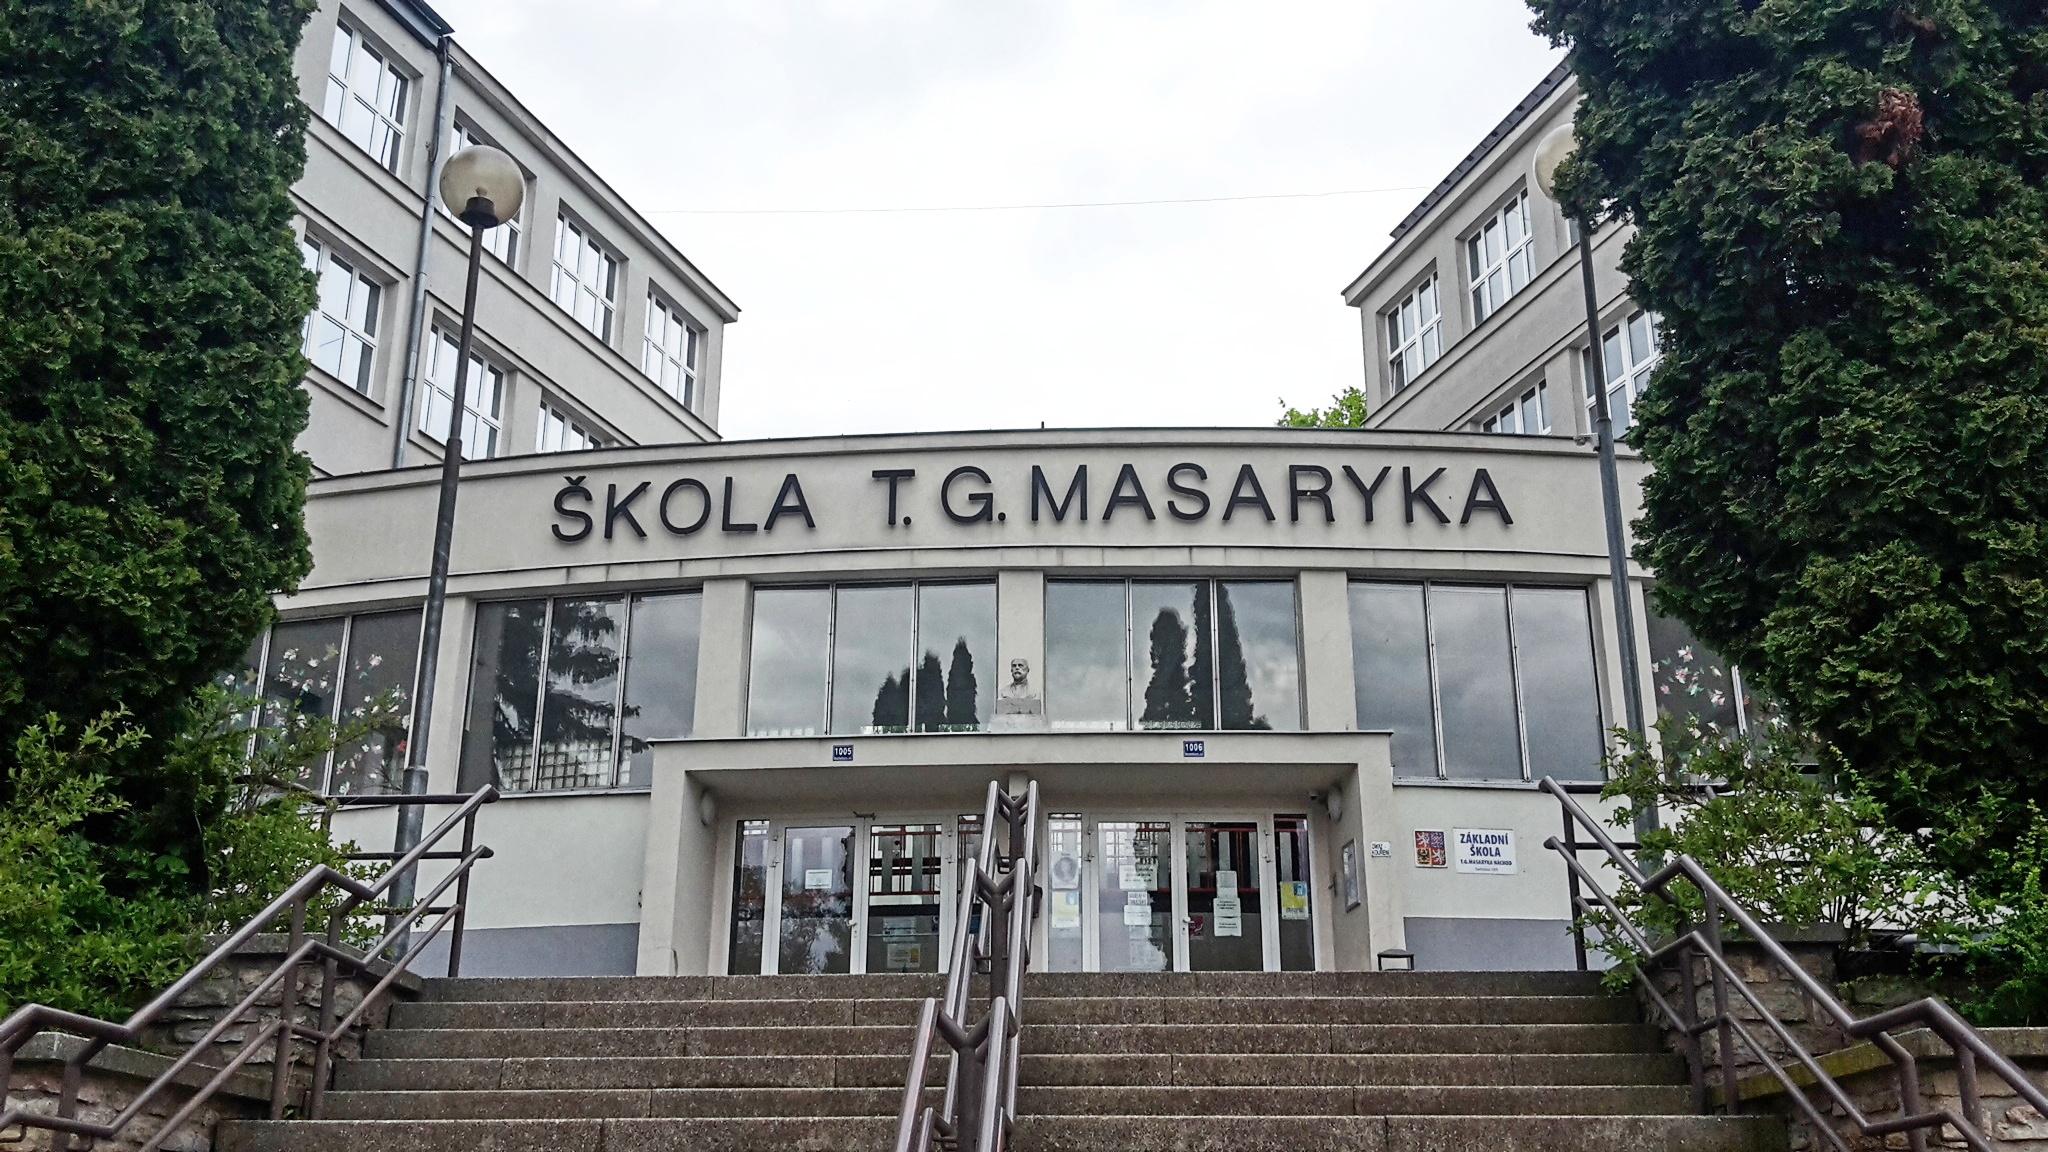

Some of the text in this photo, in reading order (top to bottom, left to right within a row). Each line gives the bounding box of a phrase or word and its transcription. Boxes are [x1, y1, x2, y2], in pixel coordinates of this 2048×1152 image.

[551, 473, 816, 542] ŠKOLA
[835, 747, 852, 756] 1005
[1185, 743, 1203, 752] 1006
[1459, 831, 1509, 845] ZÁKLADNÍ
[1469, 844, 1501, 857] ŠKOLA
